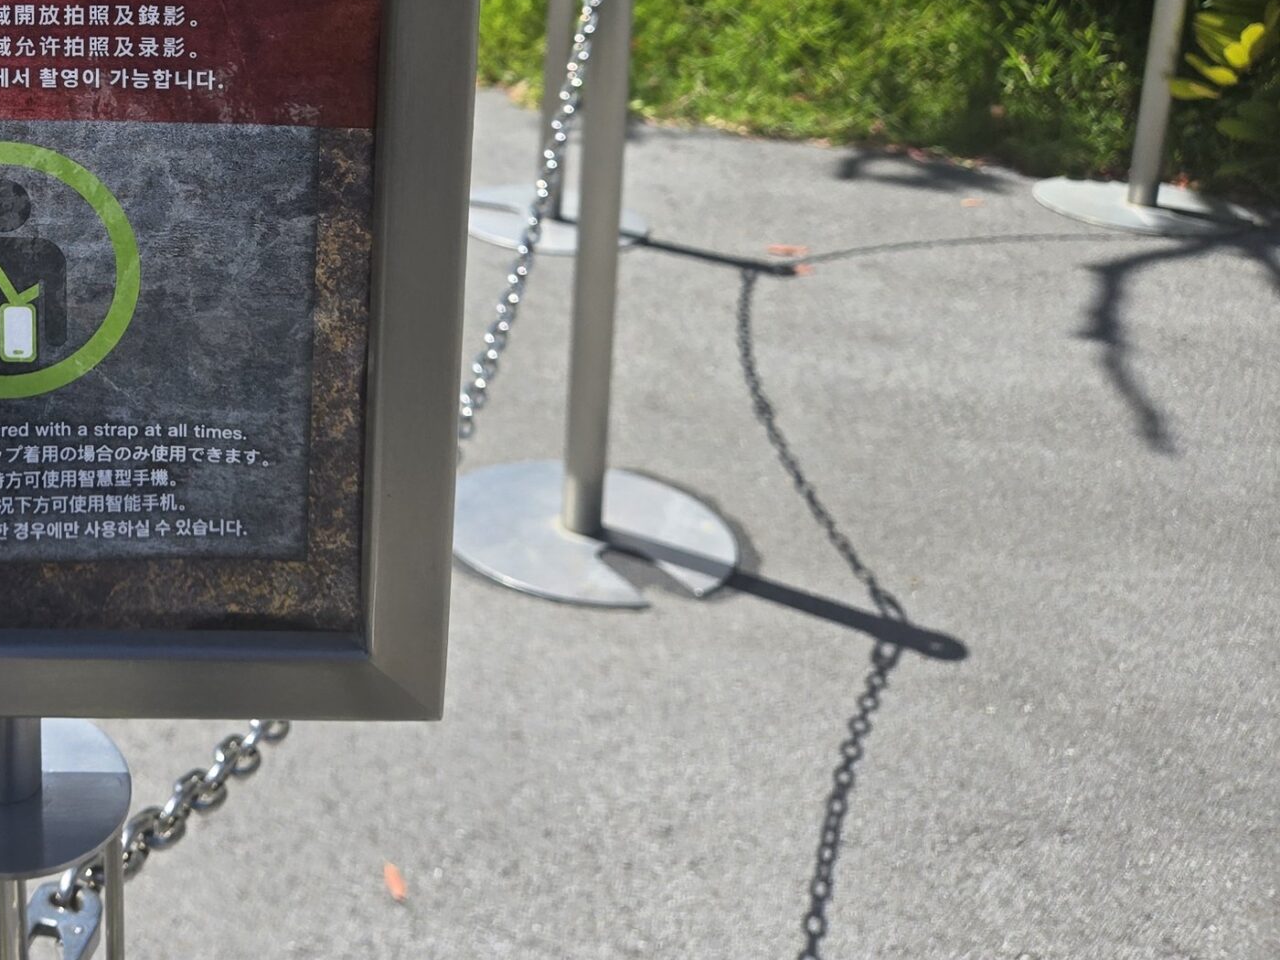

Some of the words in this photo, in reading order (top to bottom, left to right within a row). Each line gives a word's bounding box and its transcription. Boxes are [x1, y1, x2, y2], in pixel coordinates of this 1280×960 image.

[39, 68, 101, 88] 촬영이
[110, 69, 224, 90] 가능합니다.
[35, 421, 71, 437] with
[77, 425, 89, 437] a
[94, 422, 139, 439] strap
[144, 424, 162, 437] at
[168, 424, 188, 438] all
[193, 425, 247, 440] times.
[13, 521, 80, 540] 경우에만
[84, 520, 150, 538] 사용하실
[154, 520, 171, 537] 수
[176, 518, 248, 537] 있습니다.
